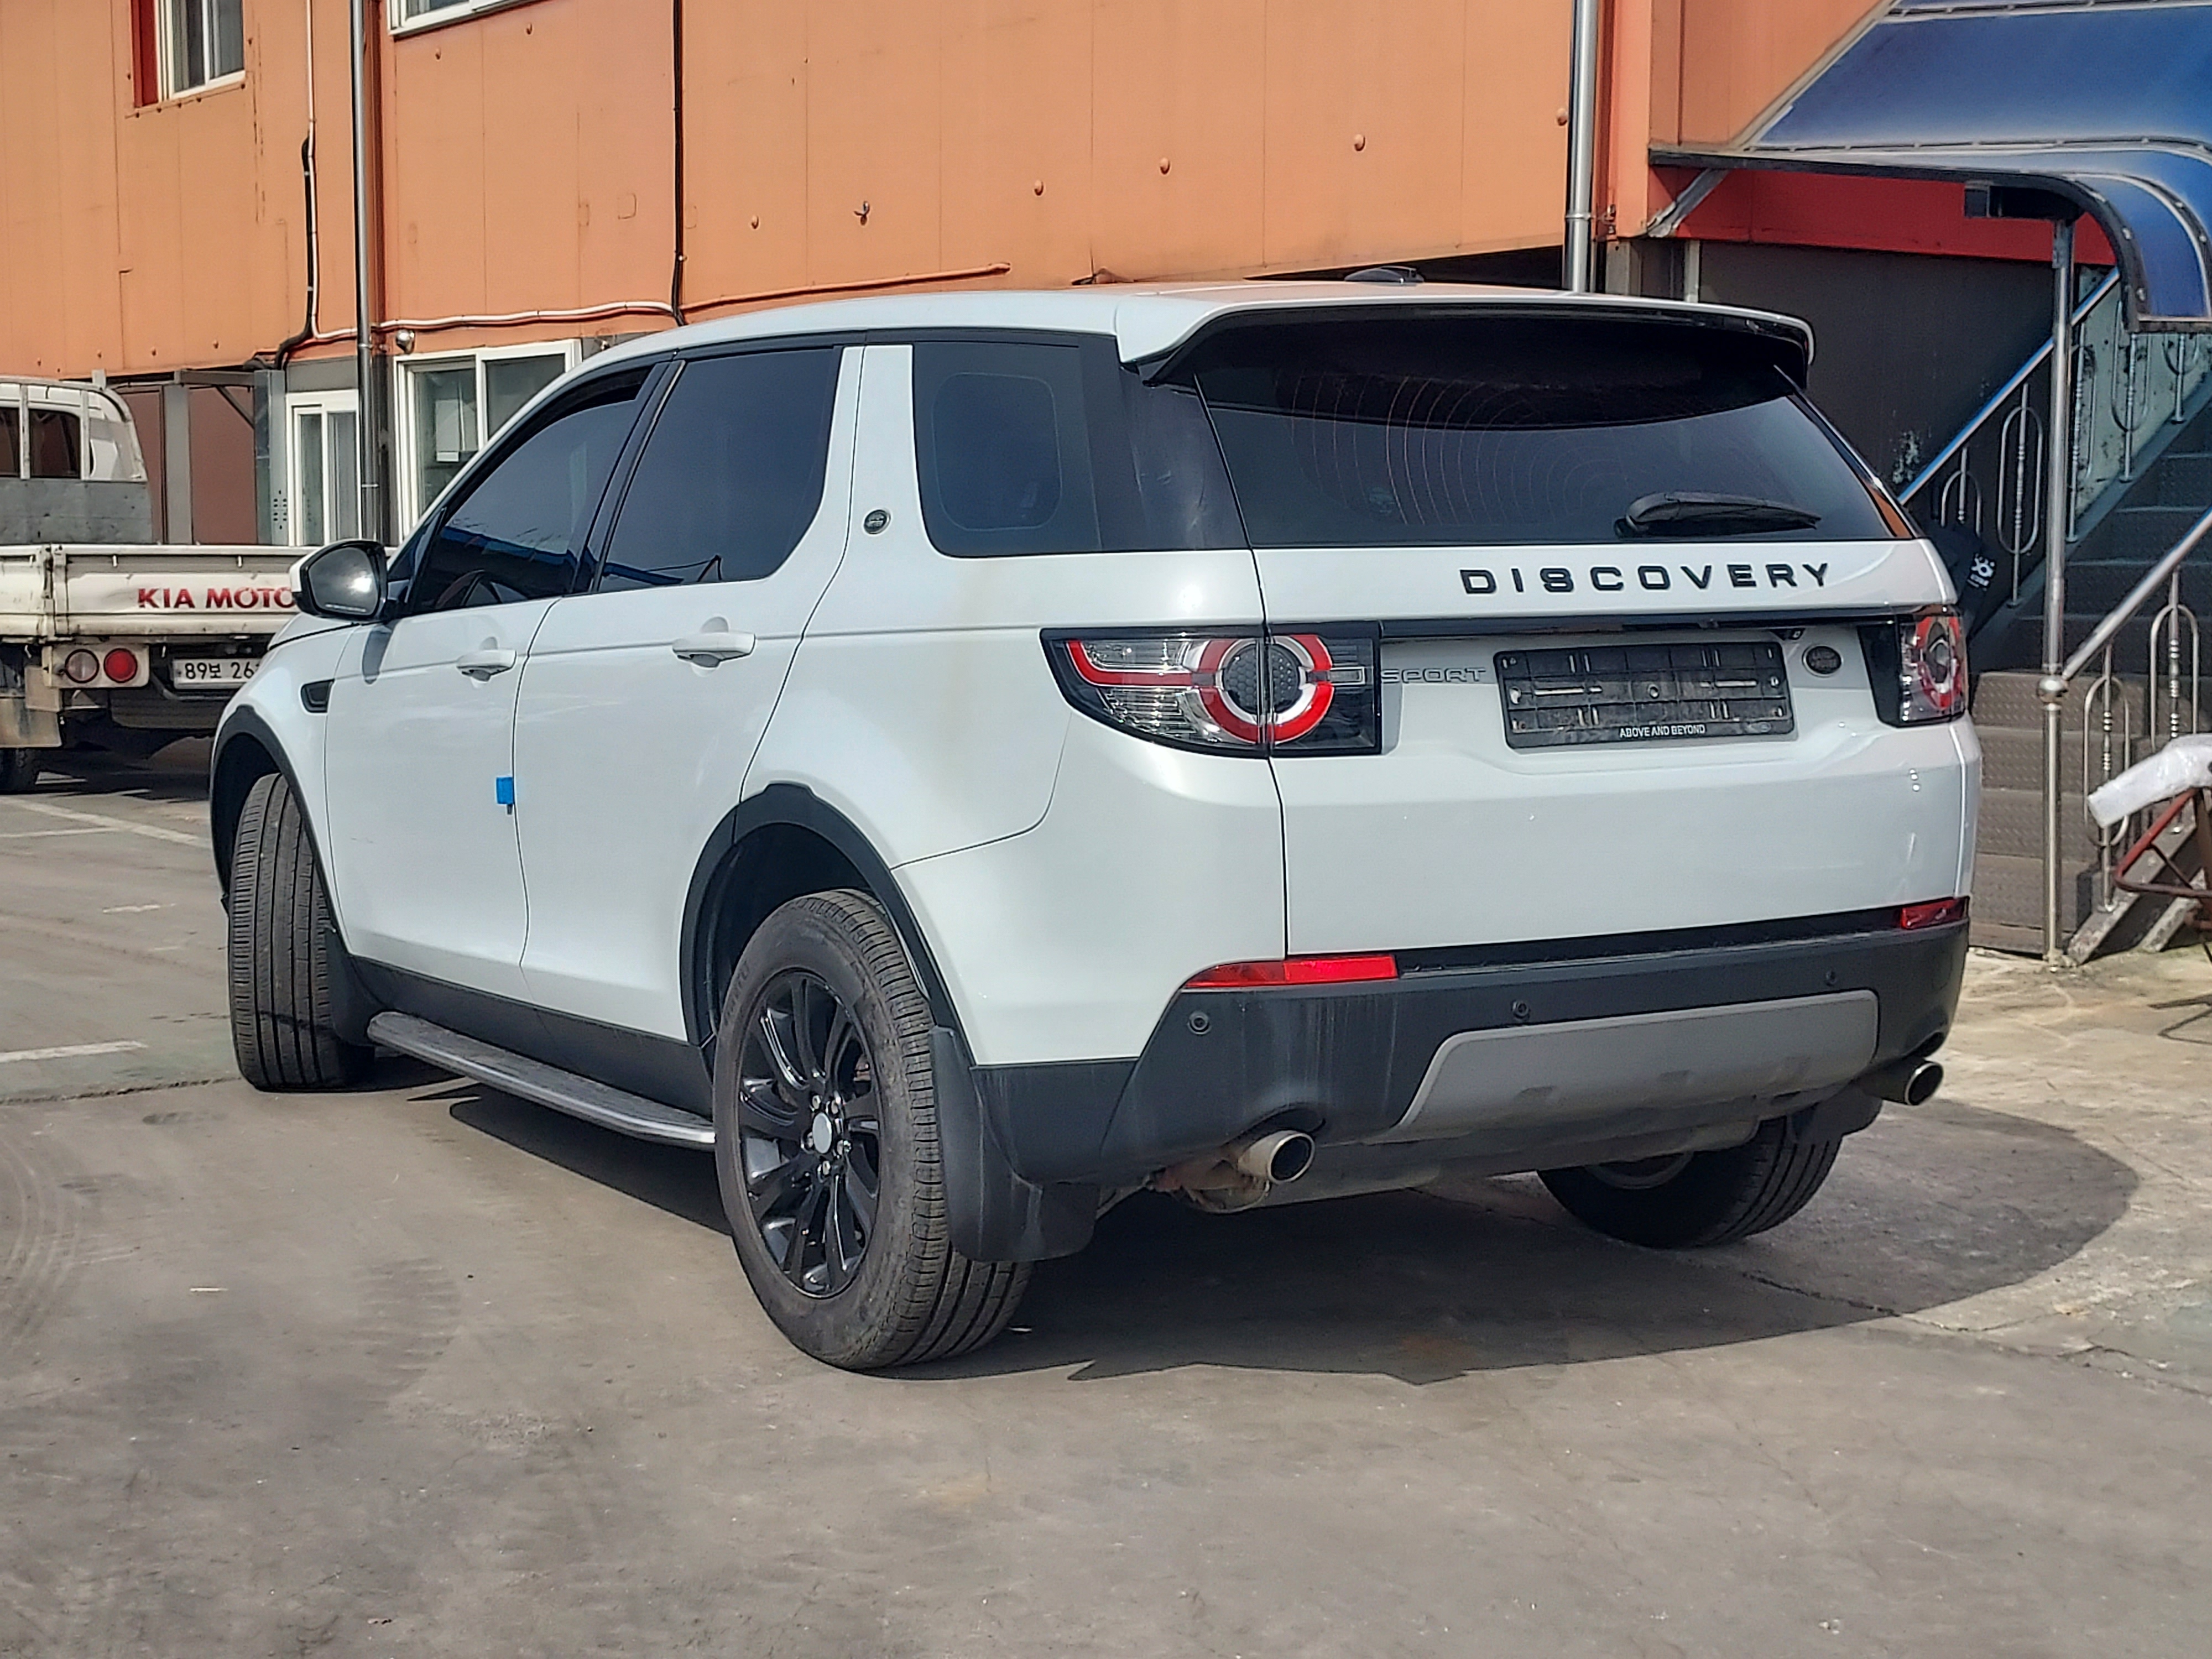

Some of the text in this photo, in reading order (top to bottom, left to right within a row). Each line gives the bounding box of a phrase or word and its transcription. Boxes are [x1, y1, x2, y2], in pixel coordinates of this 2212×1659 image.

[1459, 562, 1828, 594] DISCOVERY
[138, 588, 195, 608] KIA
[185, 662, 259, 680] 89보 26
[1381, 667, 1486, 684] SPORT
[1620, 724, 1705, 738] ABOVE AND BEYOND
